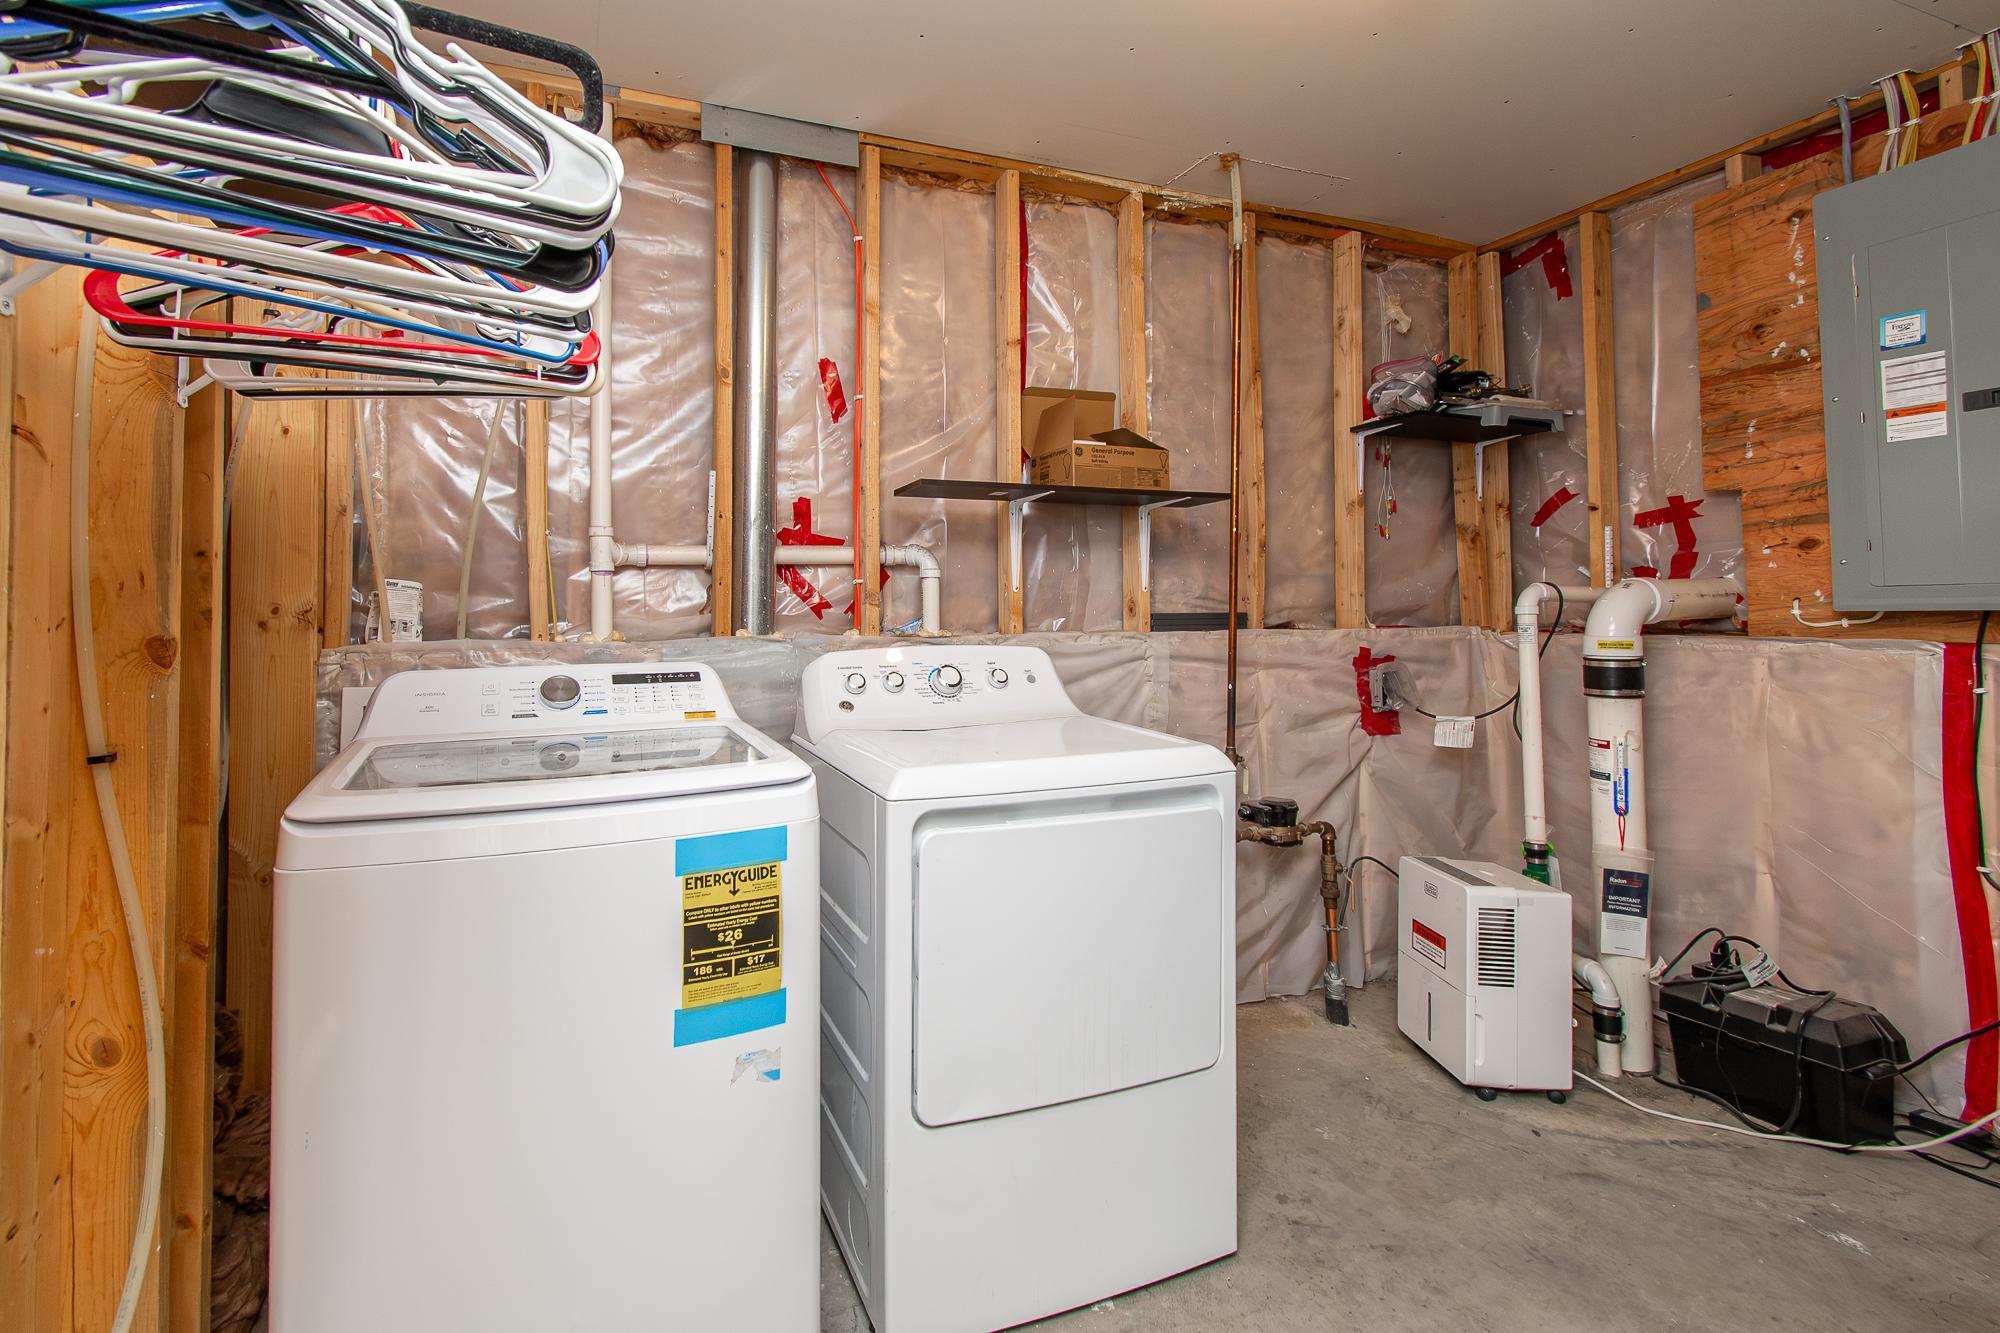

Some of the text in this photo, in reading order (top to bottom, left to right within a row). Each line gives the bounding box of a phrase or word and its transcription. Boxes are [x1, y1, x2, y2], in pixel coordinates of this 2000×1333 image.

[1114, 448, 1134, 456] Purpose
[685, 865, 777, 890] ENERGYGUIDE
[1608, 896, 1640, 904] IMPORTANT
[717, 929, 743, 942] $26
[747, 954, 765, 965] $17
[694, 965, 712, 976] 186
